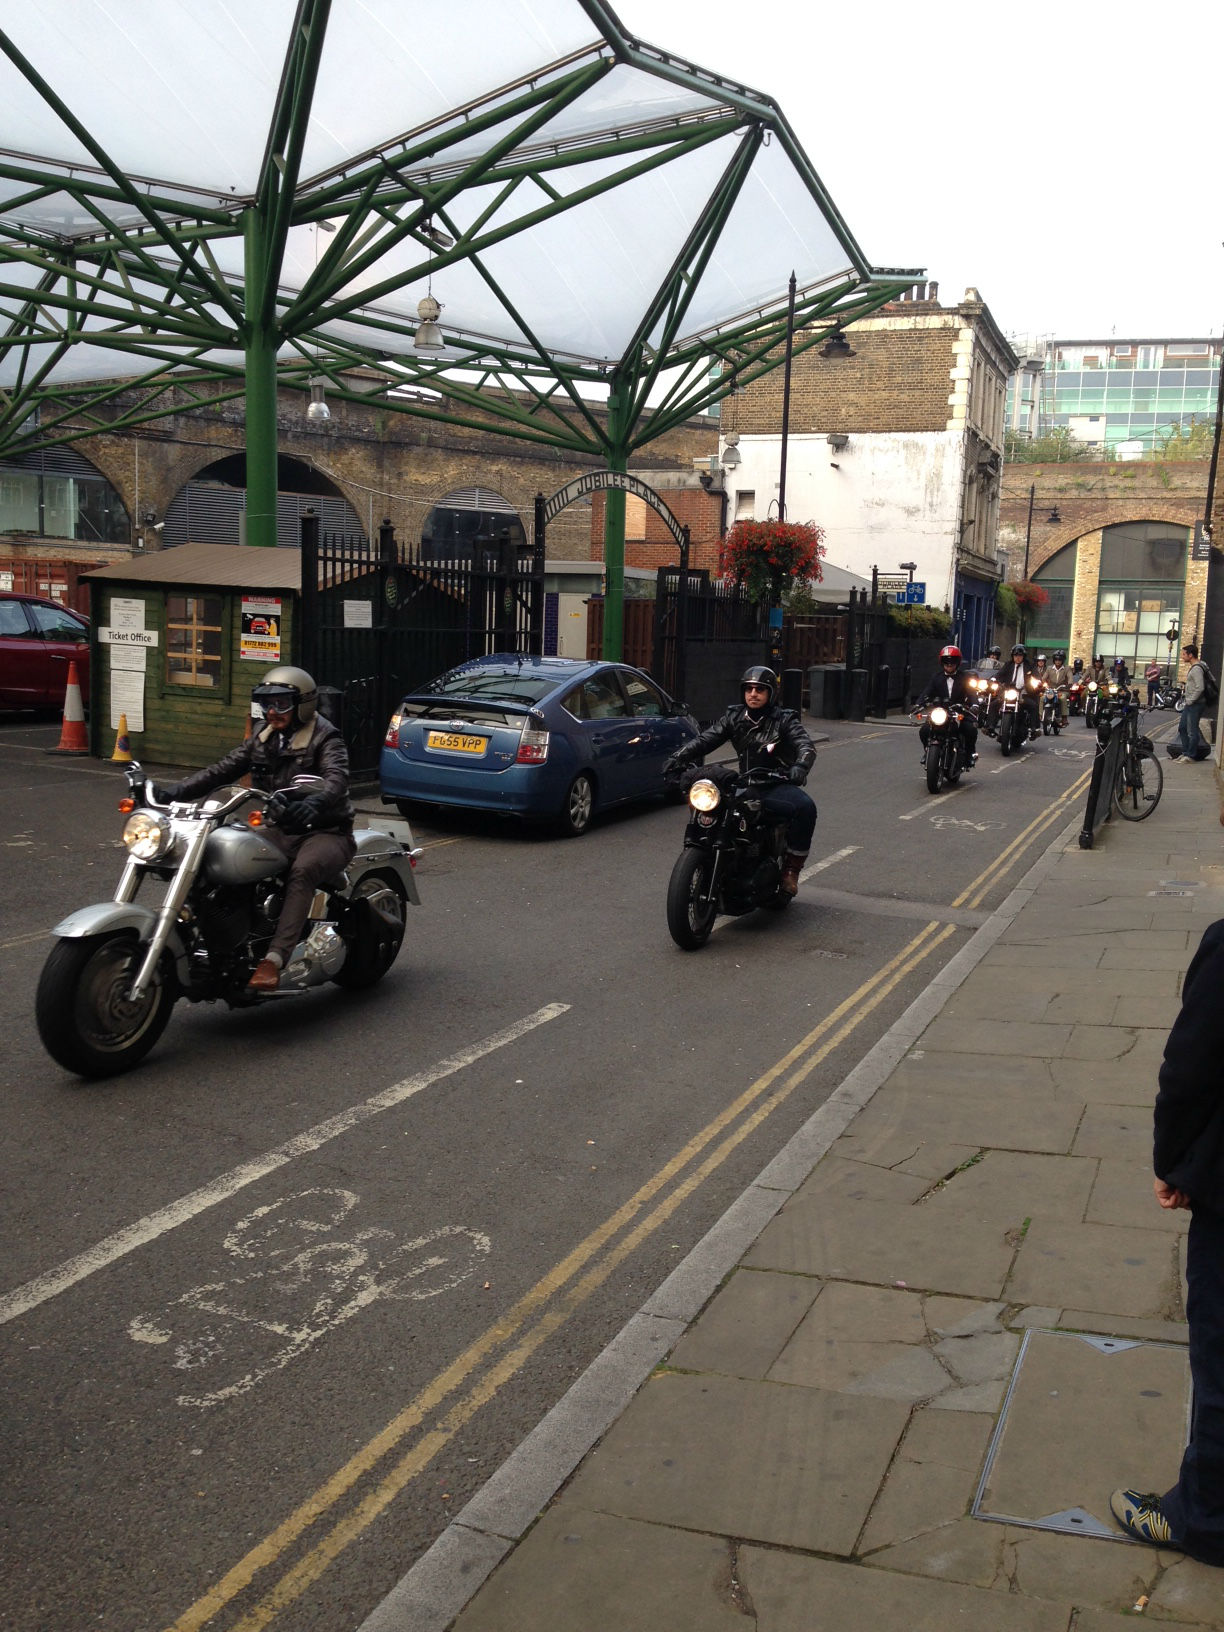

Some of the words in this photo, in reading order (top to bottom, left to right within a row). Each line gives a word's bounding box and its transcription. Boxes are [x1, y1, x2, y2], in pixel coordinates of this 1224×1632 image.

[577, 474, 627, 495] JUBILEE
[629, 480, 662, 512] PLACE
[108, 631, 129, 641] Ticket
[130, 633, 152, 642] Office
[432, 735, 460, 747] FG55
[461, 738, 482, 749] VPP
